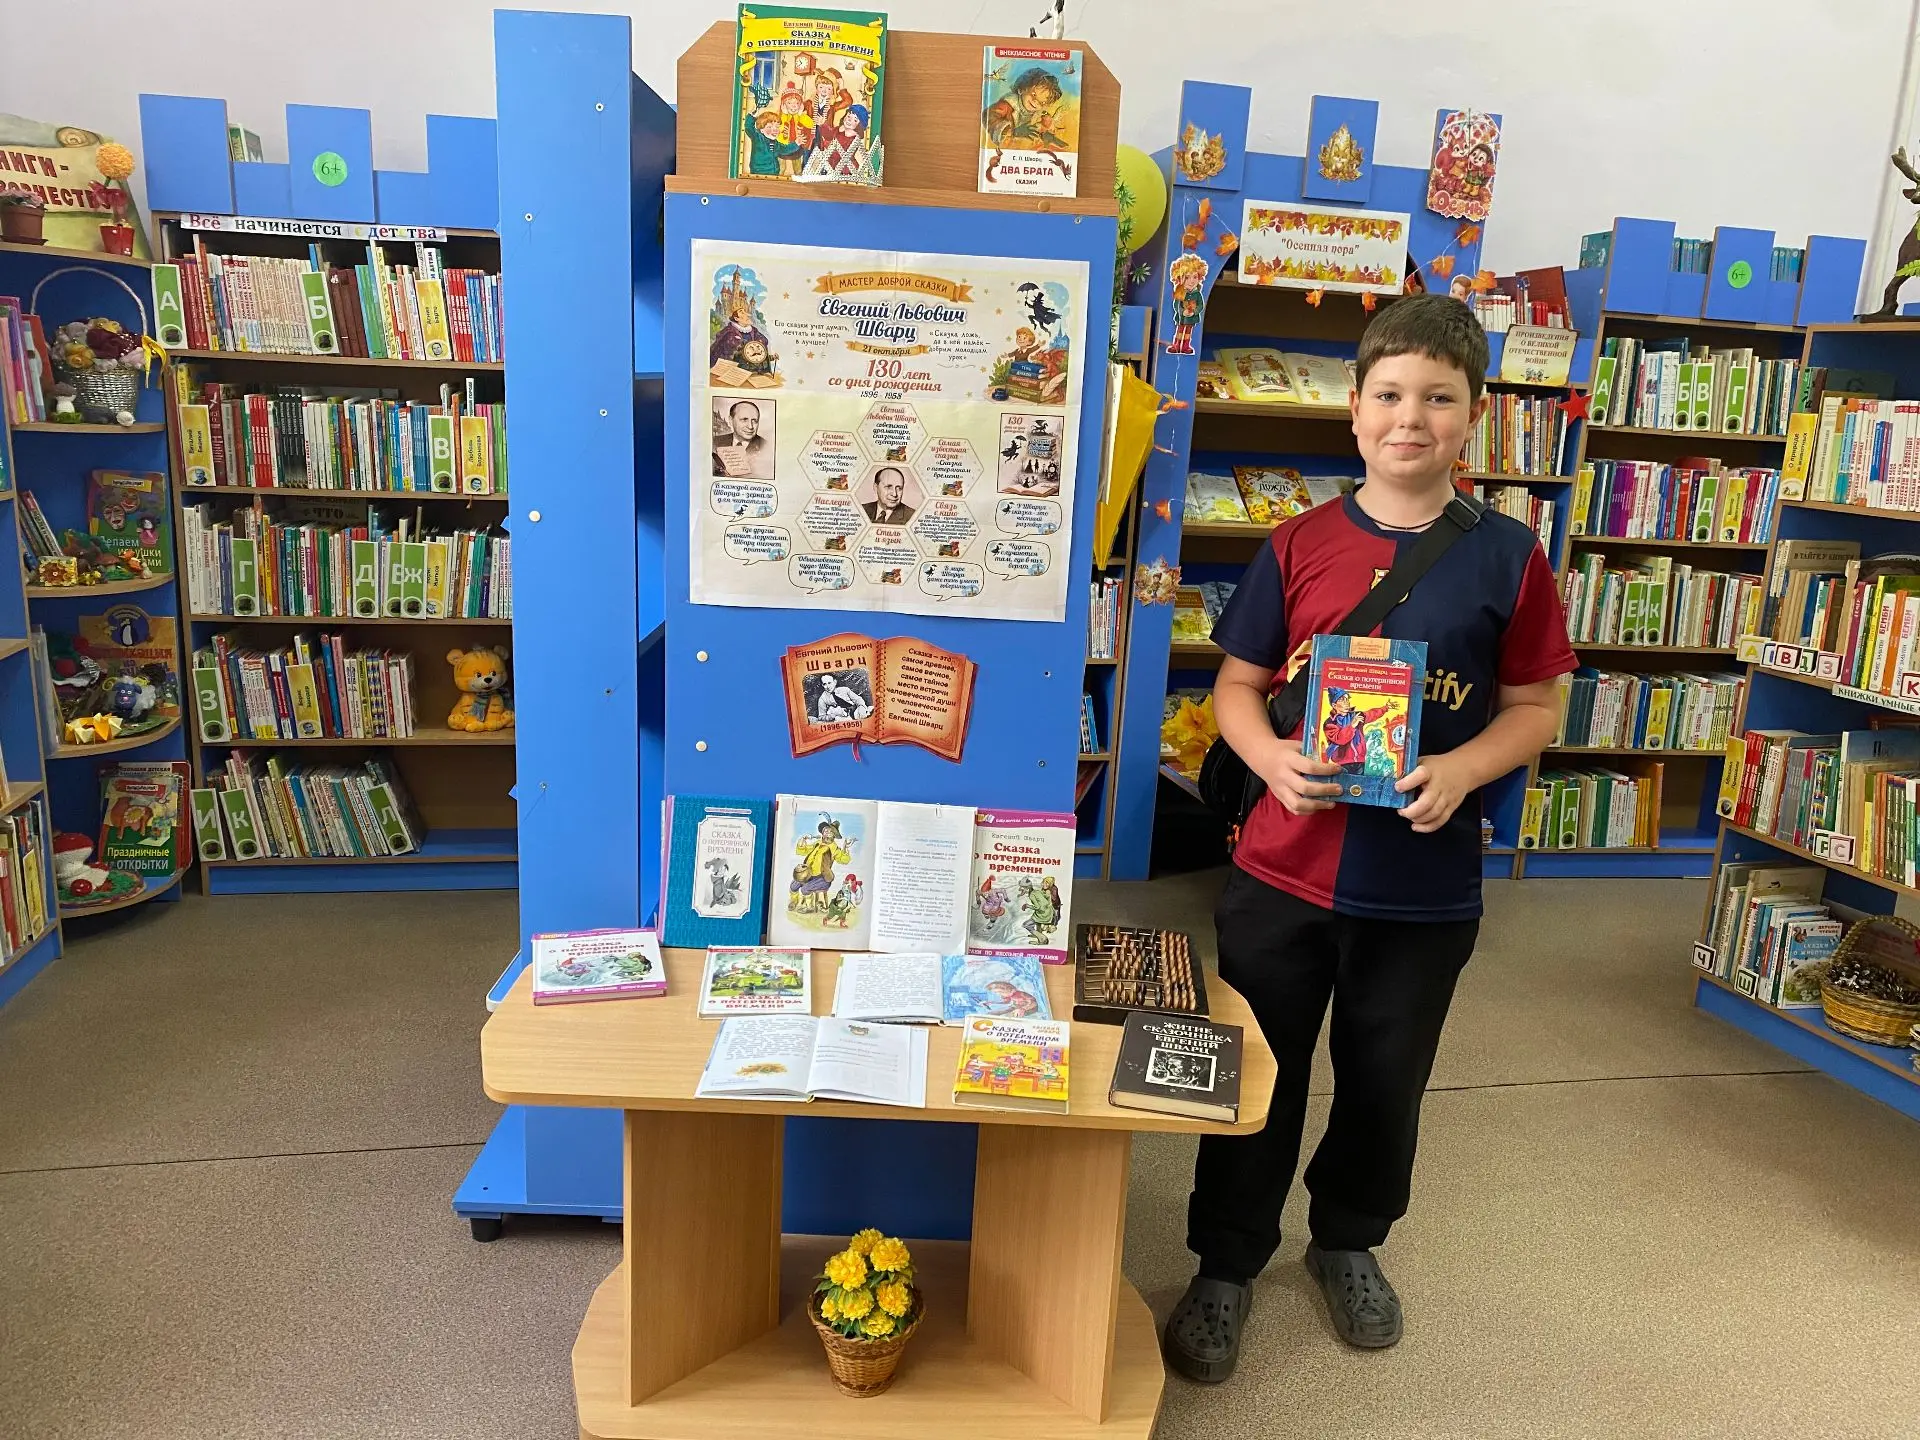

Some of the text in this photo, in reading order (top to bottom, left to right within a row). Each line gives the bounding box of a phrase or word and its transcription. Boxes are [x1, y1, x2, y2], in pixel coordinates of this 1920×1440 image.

[791, 30, 831, 40] СКАЗКА
[758, 40, 824, 48] ПОТЕРЯННОМ
[829, 41, 874, 56] ВРЕМЕНИ
[999, 49, 1066, 59] ВНЕКЛАССНОЕ ЧТЕНИЕ
[0, 150, 58, 178] НИГИ
[321, 161, 341, 175] 6+
[1000, 166, 1054, 176] ДВА БРАТА
[1434, 190, 1488, 217] Осень
[189, 213, 221, 230] Всё
[235, 217, 342, 236] начинается
[368, 227, 437, 240] детства
[1731, 268, 1746, 280] 6+
[839, 277, 948, 293] МАСТЕР ДОБРОЙ СКАЗКИ
[160, 290, 179, 312] А
[308, 295, 328, 320] Б
[820, 299, 966, 323] Евгений Львович
[855, 320, 916, 342] Шварц
[1515, 330, 1570, 342] ПРОИЗВЕДЕНИЯ
[862, 345, 911, 356] 21 октября
[1508, 347, 1567, 358] ОТЕЧЕСТВЕННОЙ
[1525, 341, 1560, 349] ВЕЛИКОЙ
[1525, 357, 1548, 365] ВОЙНЕ
[867, 358, 931, 381] 130 лет
[828, 377, 942, 392] со дня рождения
[1597, 378, 1609, 396] А
[1678, 381, 1691, 401] Б
[1697, 382, 1711, 401] В
[860, 391, 902, 400] 1896 1958
[1732, 385, 1744, 405] Г
[1008, 416, 1023, 425] 130
[433, 437, 449, 460] В
[1697, 499, 1713, 517] Д
[239, 560, 253, 583] Г
[355, 564, 375, 588] Д
[402, 564, 423, 584] Ж
[1628, 600, 1639, 618] Е
[1649, 600, 1660, 618] К
[1879, 605, 1890, 635] БЕМБИ
[795, 643, 873, 659] Евгений Львович
[908, 648, 933, 659] Сказка
[1745, 645, 1757, 658] А
[901, 655, 957, 673] самое древнее,
[1823, 661, 1833, 675] З
[901, 665, 951, 680] самое вечное,
[1327, 672, 1353, 682] Сказка
[1361, 676, 1406, 686] потерянном
[900, 673, 949, 688] самое тайное
[1349, 682, 1382, 691] времени
[897, 681, 949, 696] место встречи
[1907, 681, 1919, 696] К
[199, 689, 218, 711] З
[886, 687, 957, 708] человеческой души
[1838, 687, 1915, 712] КНИЖКИ УМНЫЕ
[896, 698, 948, 713] человеческим
[888, 712, 944, 730] Евгений Шварц
[902, 708, 932, 719] словом.
[820, 720, 863, 733] (1896-1958)
[195, 808, 217, 829] И
[232, 810, 250, 829] К
[1564, 806, 1577, 822] Л
[711, 831, 742, 839] СКАЗКА
[106, 847, 169, 860] Праздничные
[707, 846, 743, 855] ВРЕМЕНИ
[993, 842, 1040, 855] Сказка
[1834, 841, 1846, 857] С
[116, 859, 169, 871] ОТКРЫТКИ
[983, 853, 1061, 866] потерянном
[989, 863, 1043, 874] времени
[972, 1019, 1025, 1034] СКАЗКА
[1142, 1024, 1232, 1043] СКАЗОЧНИКА
[1163, 1022, 1213, 1035] ЖИТИЕ
[996, 1032, 1060, 1042] ПОТЕРЯННОМ
[1000, 1037, 1047, 1046] ВРЕМЕНИ
[1155, 1034, 1219, 1050] ЕВГЕНИЙ
[1160, 1042, 1210, 1055] ШВАРЦ
